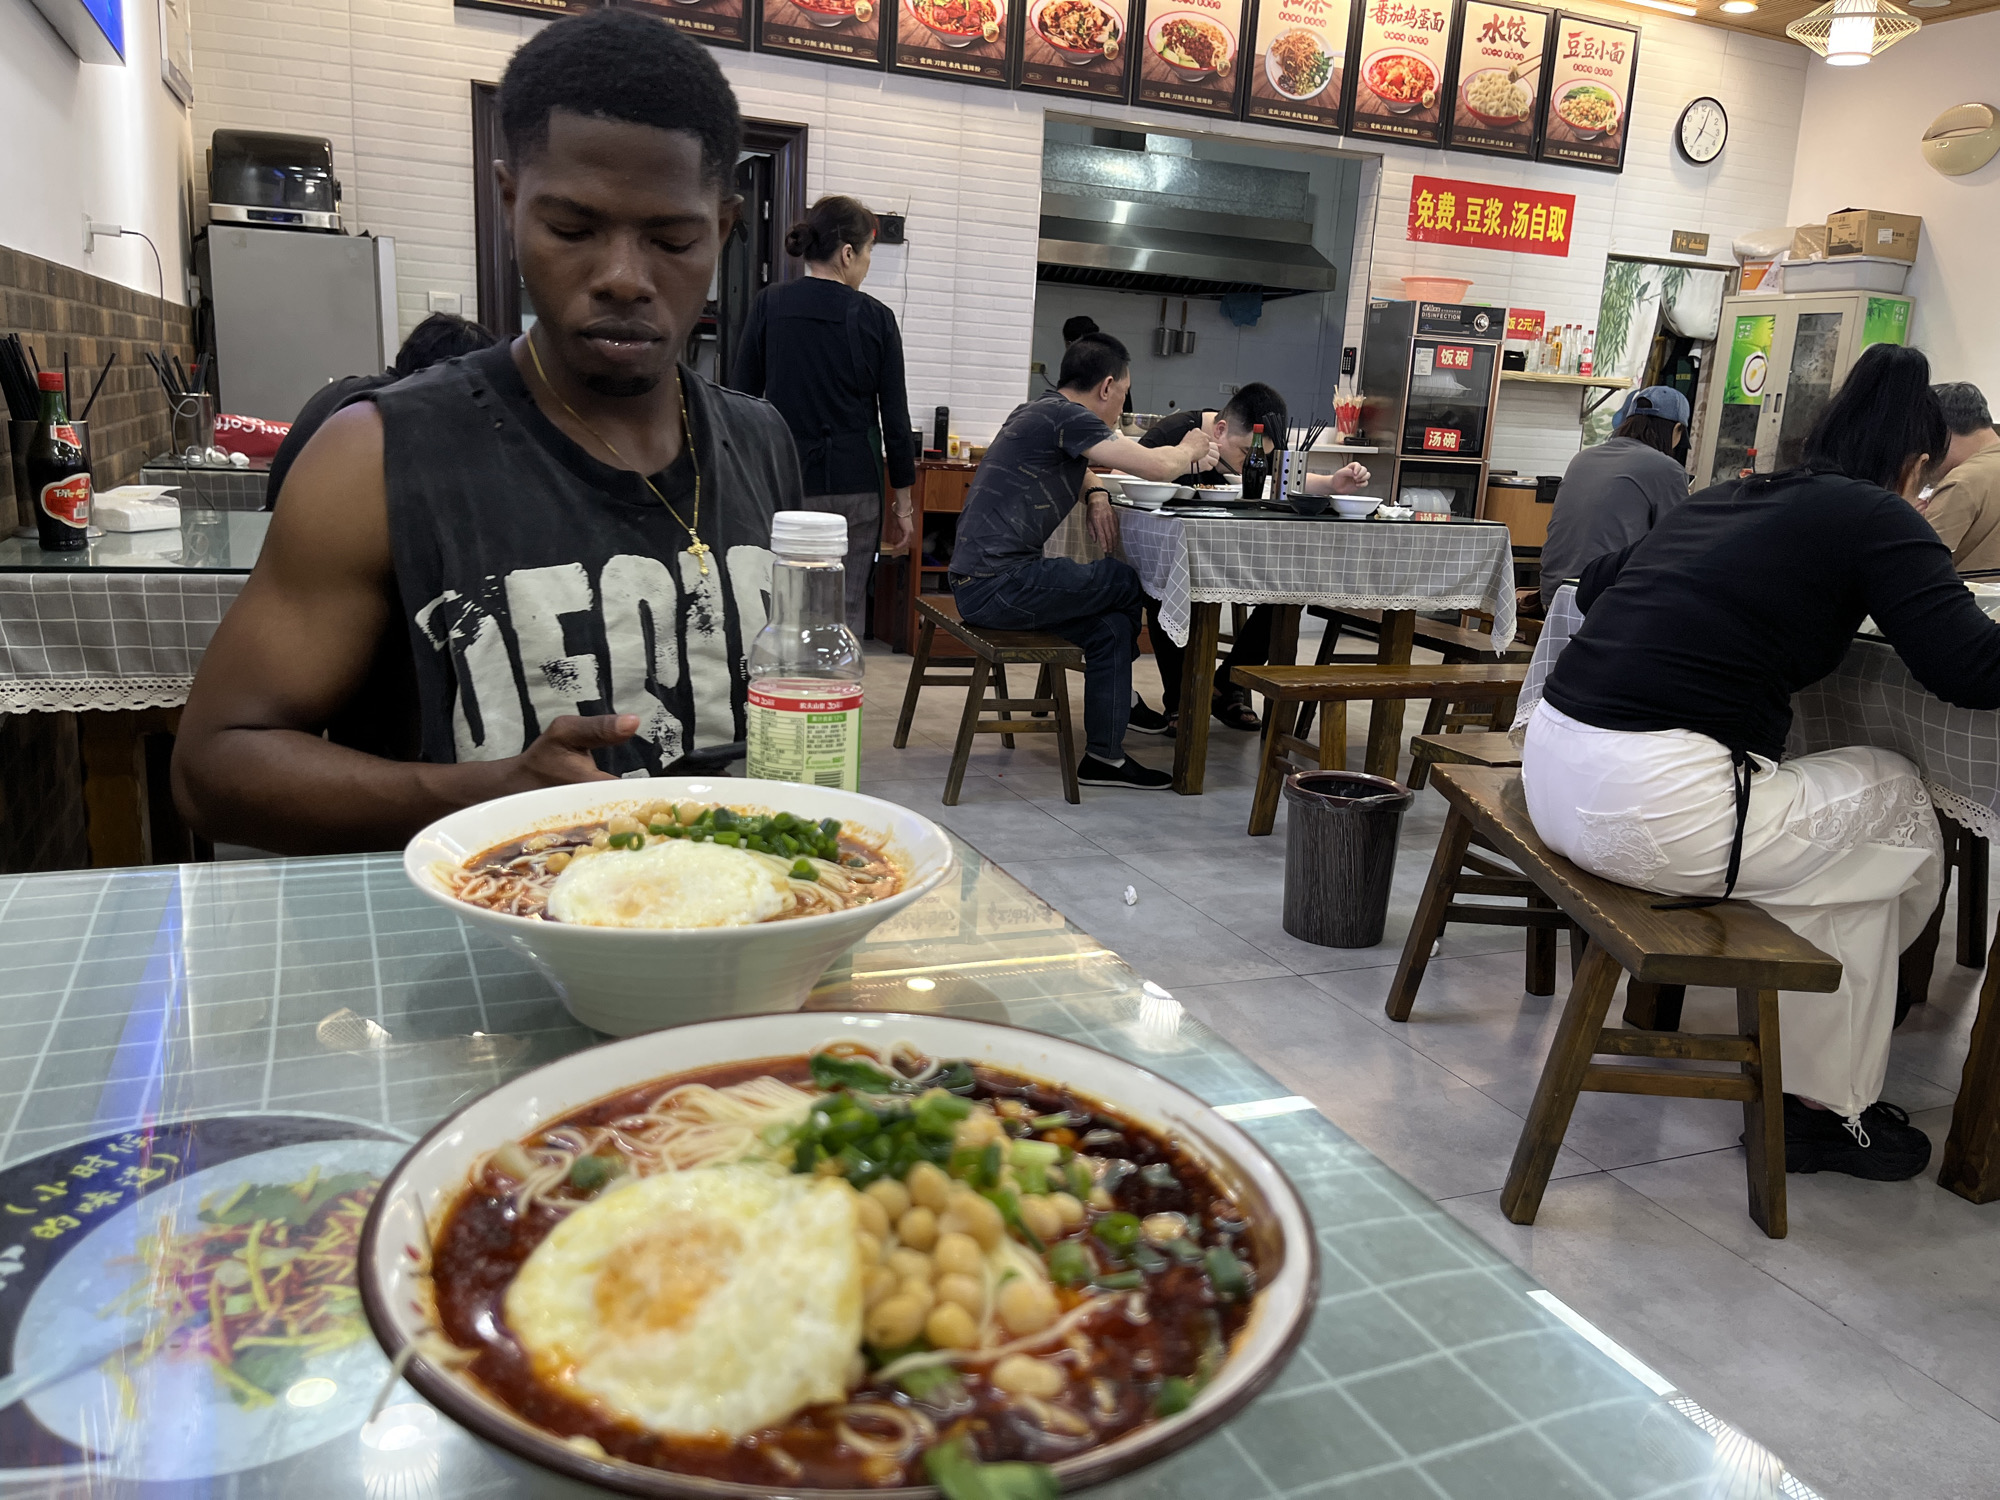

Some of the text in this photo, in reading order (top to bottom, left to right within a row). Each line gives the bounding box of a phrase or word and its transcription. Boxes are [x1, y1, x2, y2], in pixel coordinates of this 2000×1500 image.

[1367, 0, 1445, 33] 番茄鸡蛋面
[1476, 13, 1531, 49] 水饺
[1563, 31, 1626, 65] 豆豆小面
[1421, 312, 1461, 320] DISINFECTION
[1441, 349, 1469, 367] 饭碗
[261, 425, 290, 436] otti
[1428, 430, 1457, 448] 汤碗
